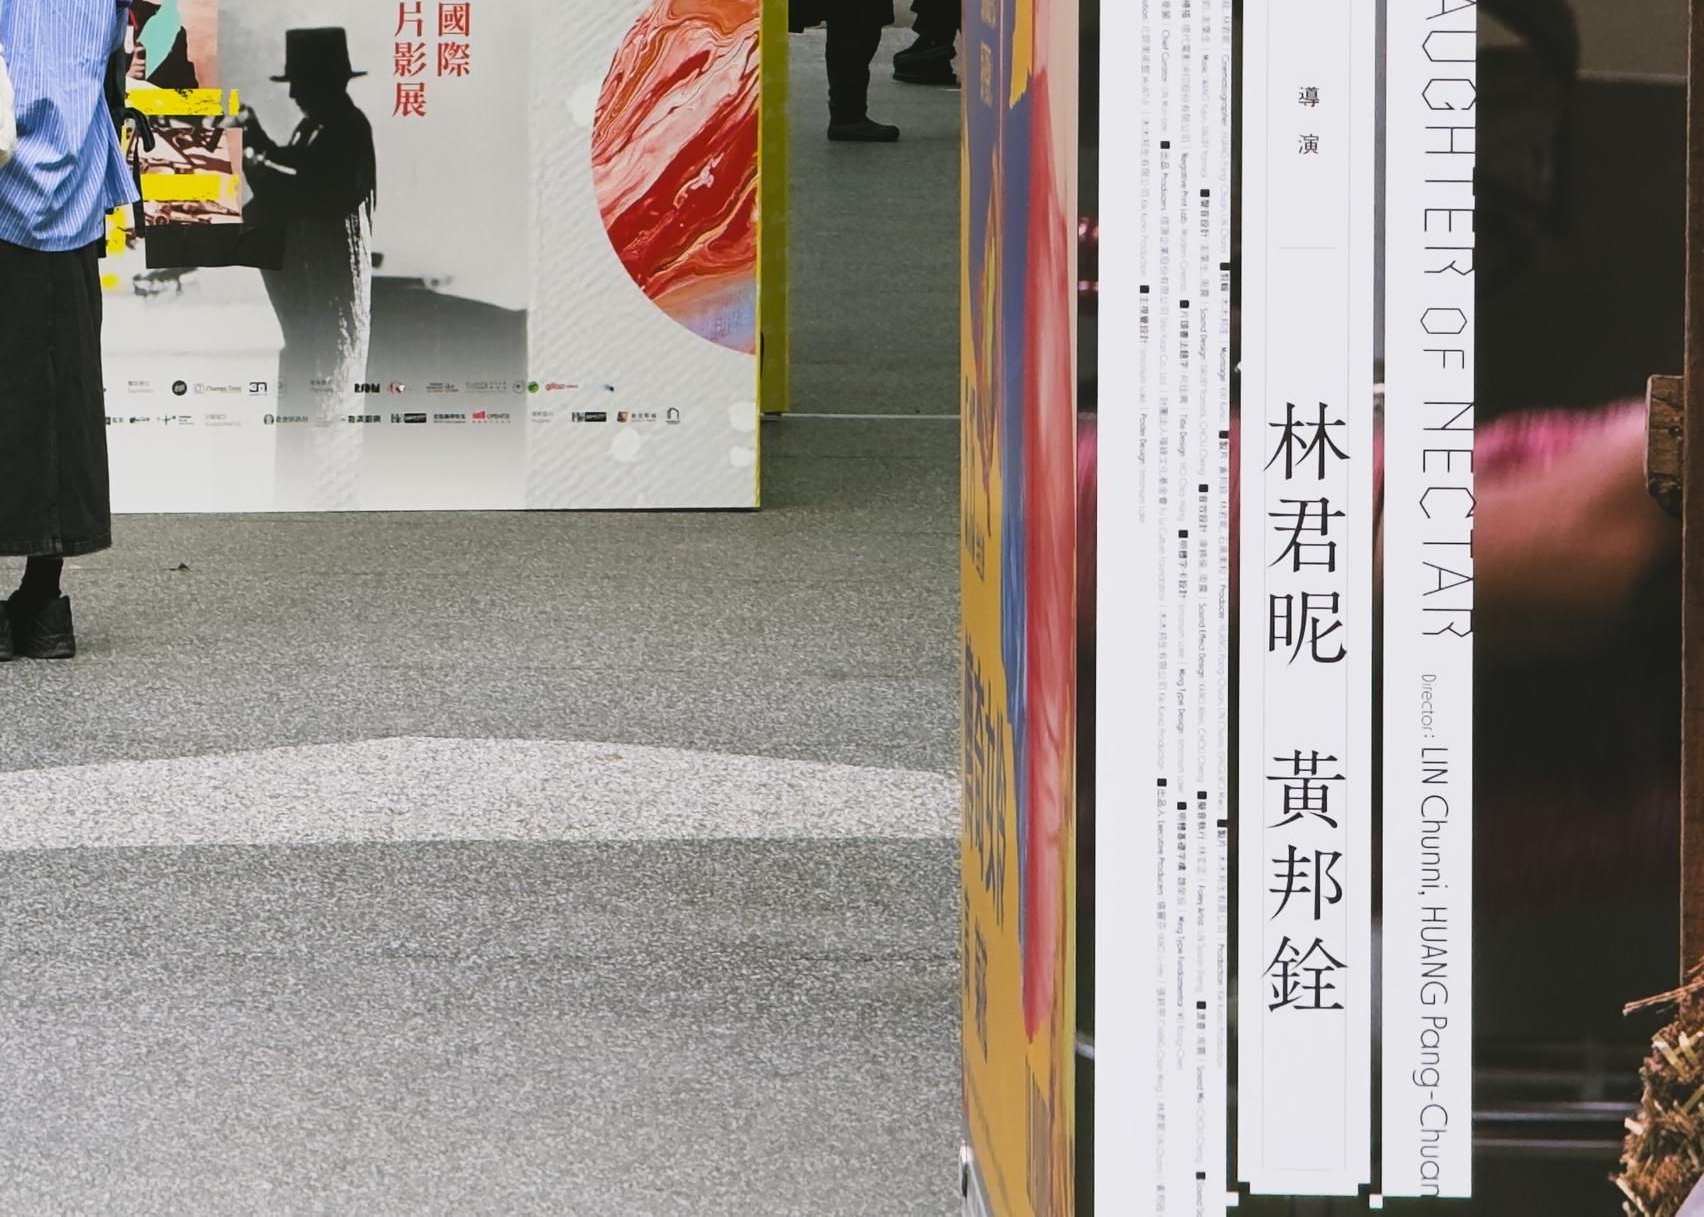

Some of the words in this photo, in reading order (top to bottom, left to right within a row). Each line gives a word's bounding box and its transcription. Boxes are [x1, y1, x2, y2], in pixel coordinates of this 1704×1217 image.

[1296, 85, 1320, 156] 導演
[1197, 334, 1208, 360] Design
[1421, 308, 1468, 369] OF
[1177, 431, 1188, 457] Design
[1262, 401, 1351, 667] 林君昵
[1420, 402, 1476, 638] NECTAR
[1198, 602, 1207, 628] Sound
[1195, 653, 1206, 679] Design
[1175, 708, 1186, 734] Design
[1421, 673, 1438, 739] Director:
[1421, 747, 1448, 784] LIN
[1418, 795, 1449, 896] Chunni,
[1261, 749, 1348, 1013] 黃邦銓
[1420, 907, 1448, 1005] HUANG
[1412, 1016, 1448, 1198] Pang-Chuan
